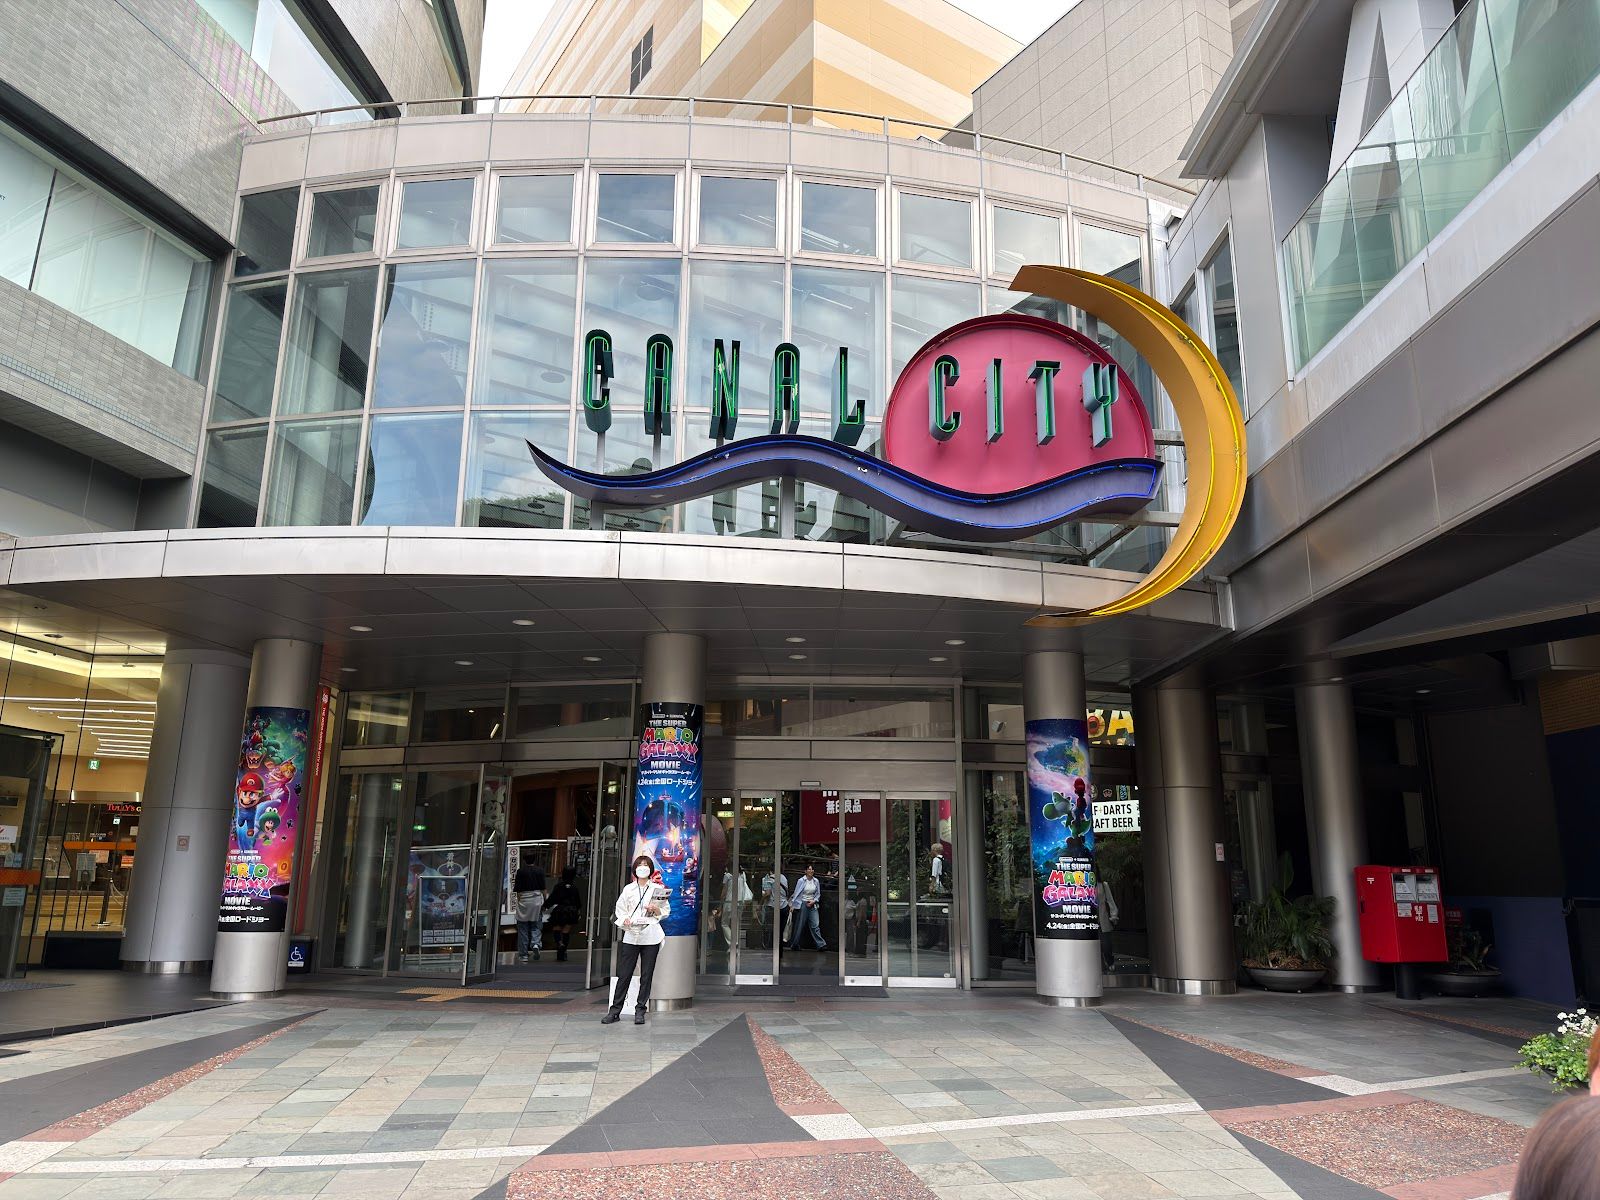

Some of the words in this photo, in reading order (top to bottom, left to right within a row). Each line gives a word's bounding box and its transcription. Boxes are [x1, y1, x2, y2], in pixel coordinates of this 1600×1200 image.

[583, 329, 866, 446] CANAL
[928, 354, 1120, 448] CITY
[643, 727, 694, 742] MARIO
[639, 741, 698, 763] GALAXY
[650, 761, 681, 769] MOVIE
[1104, 804, 1132, 815] DARTS
[1093, 818, 1110, 829] AFT
[1112, 817, 1134, 828] BEER
[1055, 863, 1071, 871] THE
[1071, 863, 1091, 871] SUPER
[1048, 869, 1097, 886] MARIO
[222, 878, 277, 898] ALAXY
[224, 896, 251, 906] MOVIE
[1062, 905, 1092, 914] MOVIE
